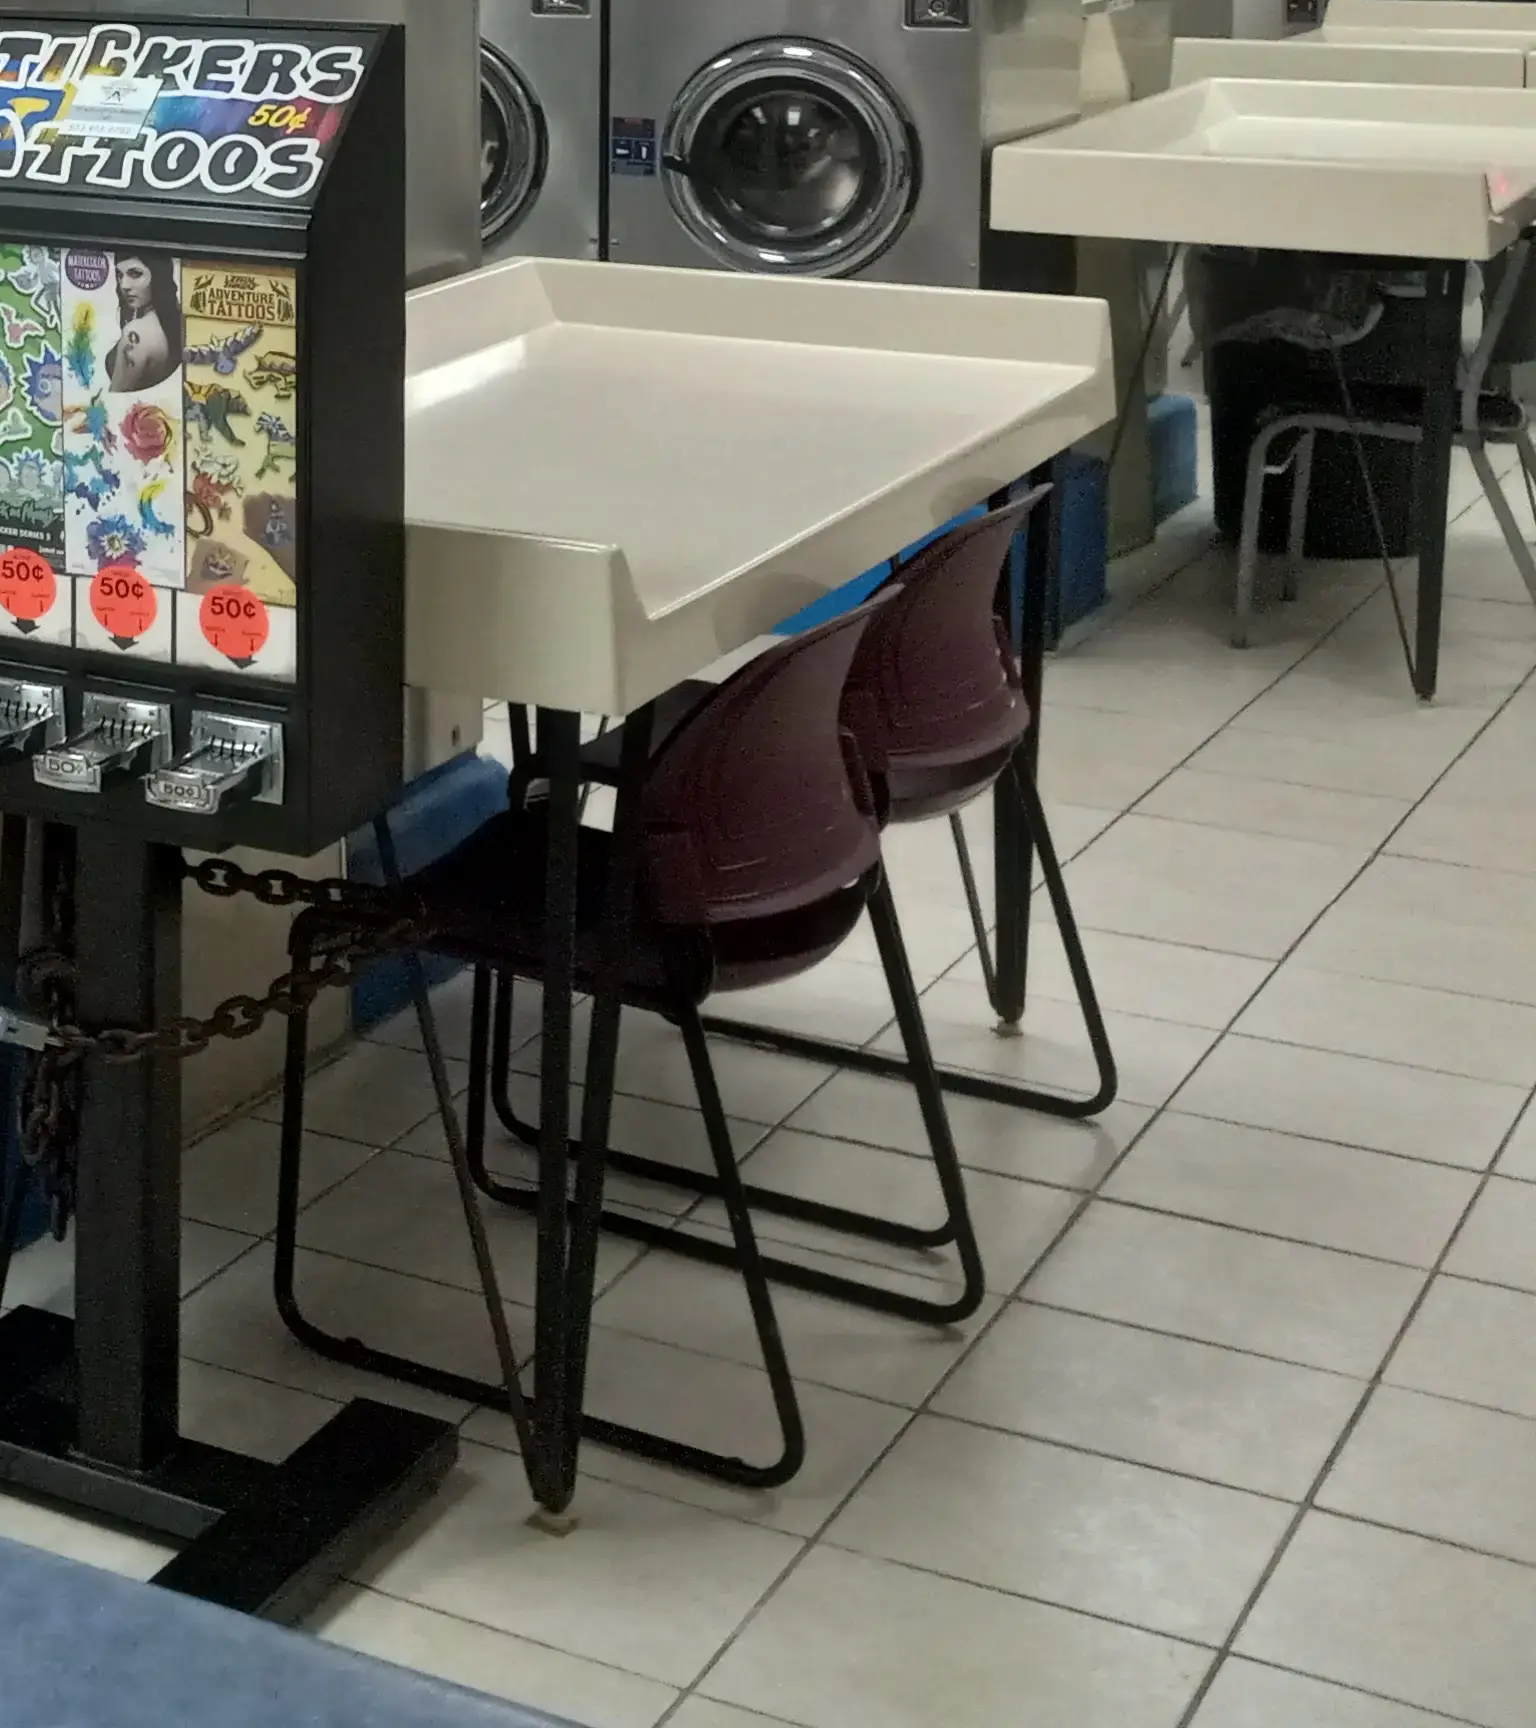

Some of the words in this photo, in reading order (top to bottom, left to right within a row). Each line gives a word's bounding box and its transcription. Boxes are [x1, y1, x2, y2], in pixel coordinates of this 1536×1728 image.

[248, 101, 310, 134] 50¢
[208, 287, 275, 305] ADVENTURE
[208, 299, 276, 322] TATTOOS
[2, 560, 44, 582] 50¢
[99, 576, 144, 600] 50¢
[210, 595, 256, 620] 50¢
